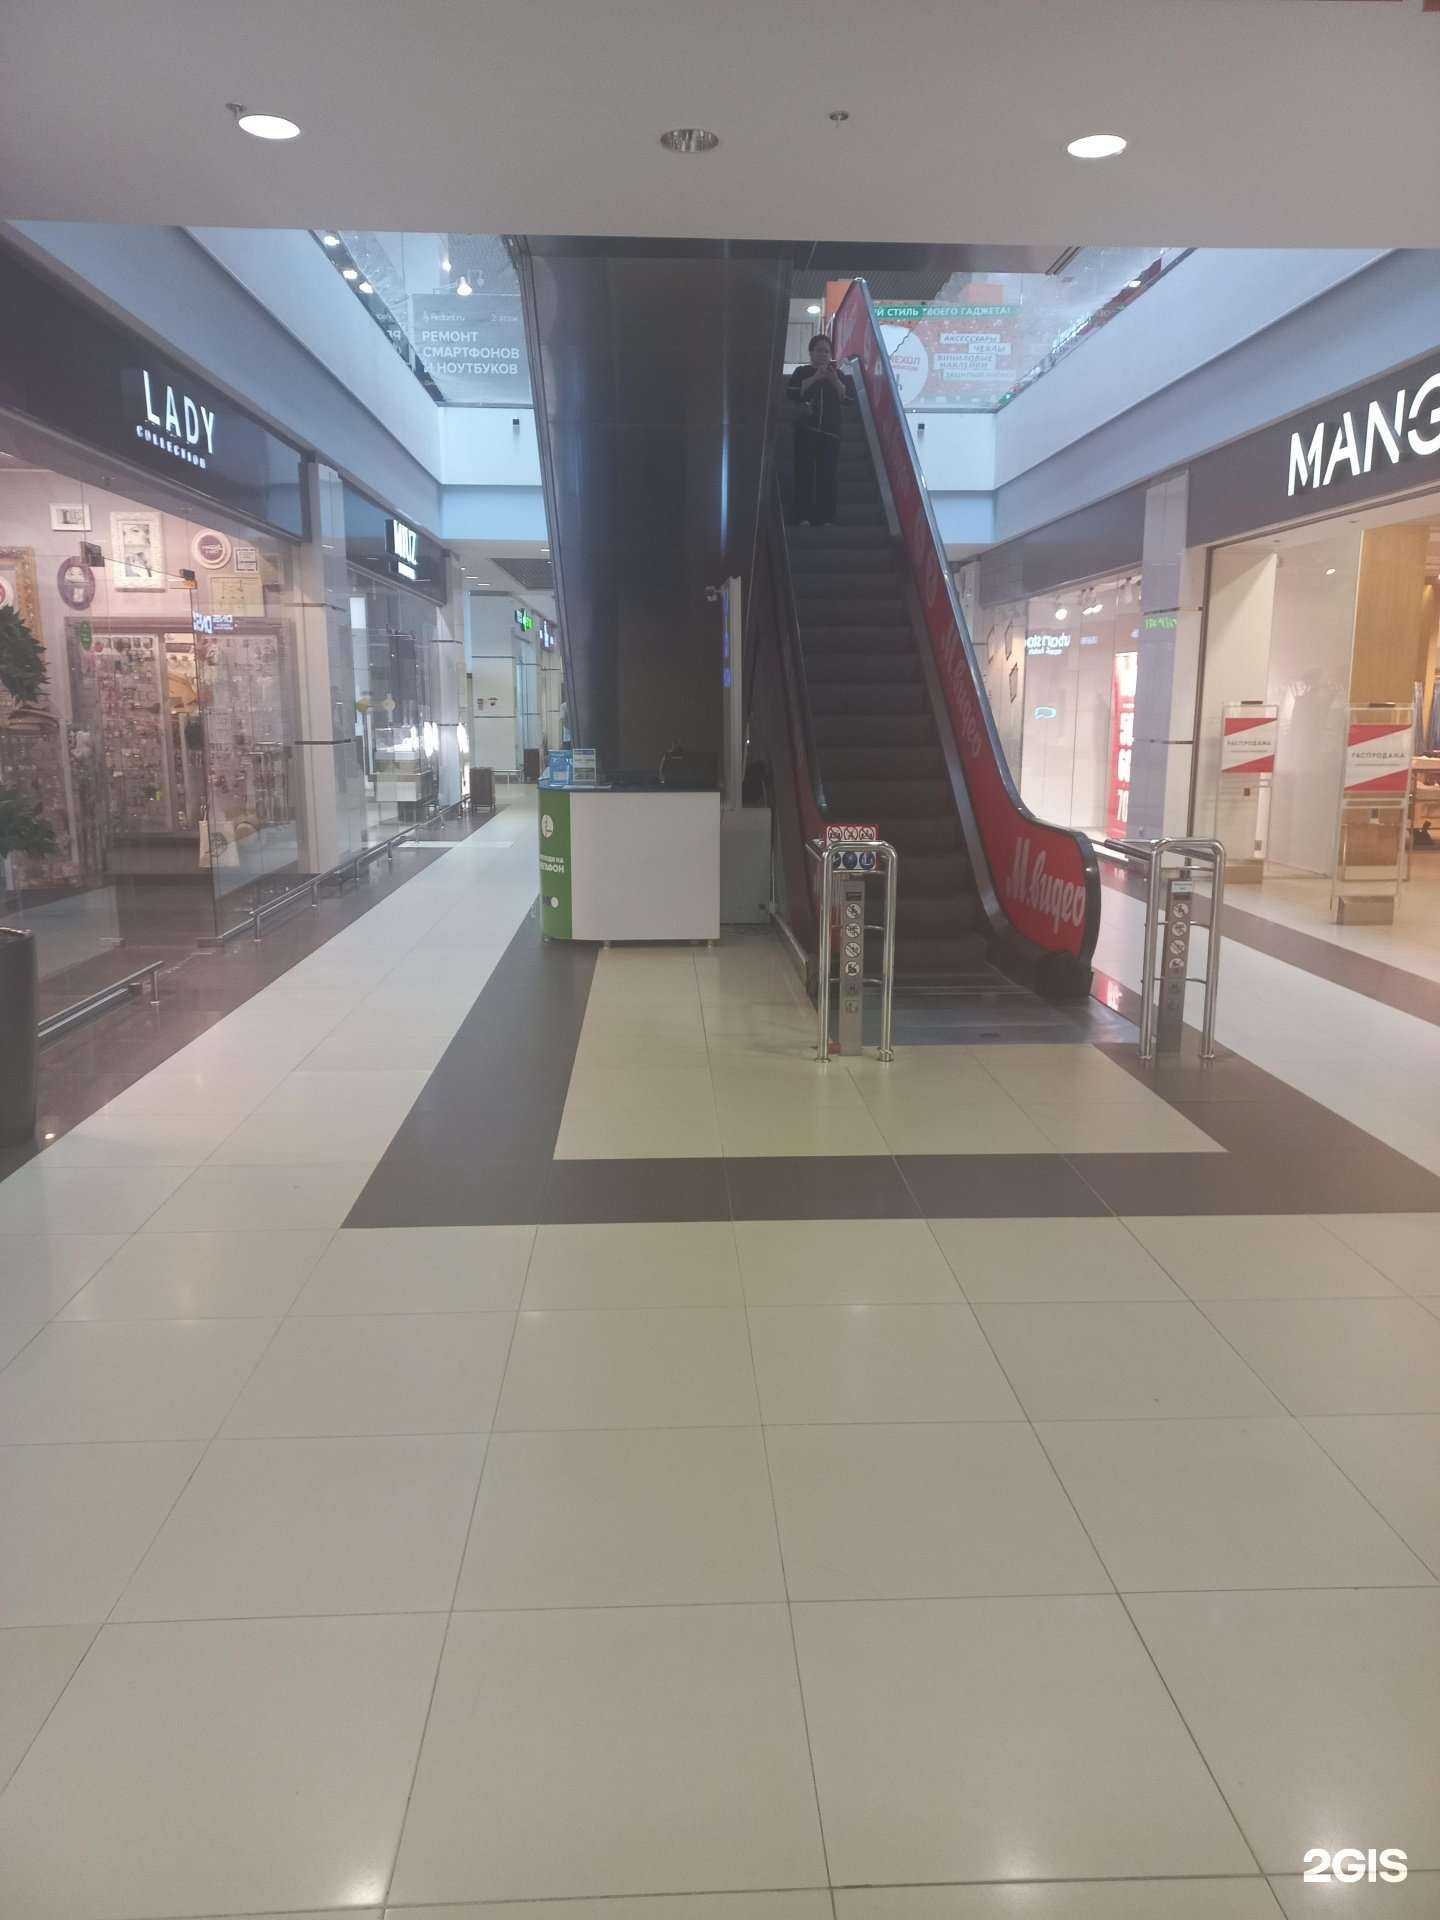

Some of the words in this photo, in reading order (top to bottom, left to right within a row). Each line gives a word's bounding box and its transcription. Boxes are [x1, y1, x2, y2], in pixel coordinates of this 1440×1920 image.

[887, 308, 919, 316] СТИЛЬ
[422, 330, 480, 342] РЕМОНТ
[422, 346, 521, 359] СМАРТФОНОВ
[437, 362, 519, 375] НОУТБУКОВ
[143, 369, 215, 454] LADY
[136, 424, 206, 469] COLLECTION
[1352, 751, 1406, 760] РАСПРОДАЖА
